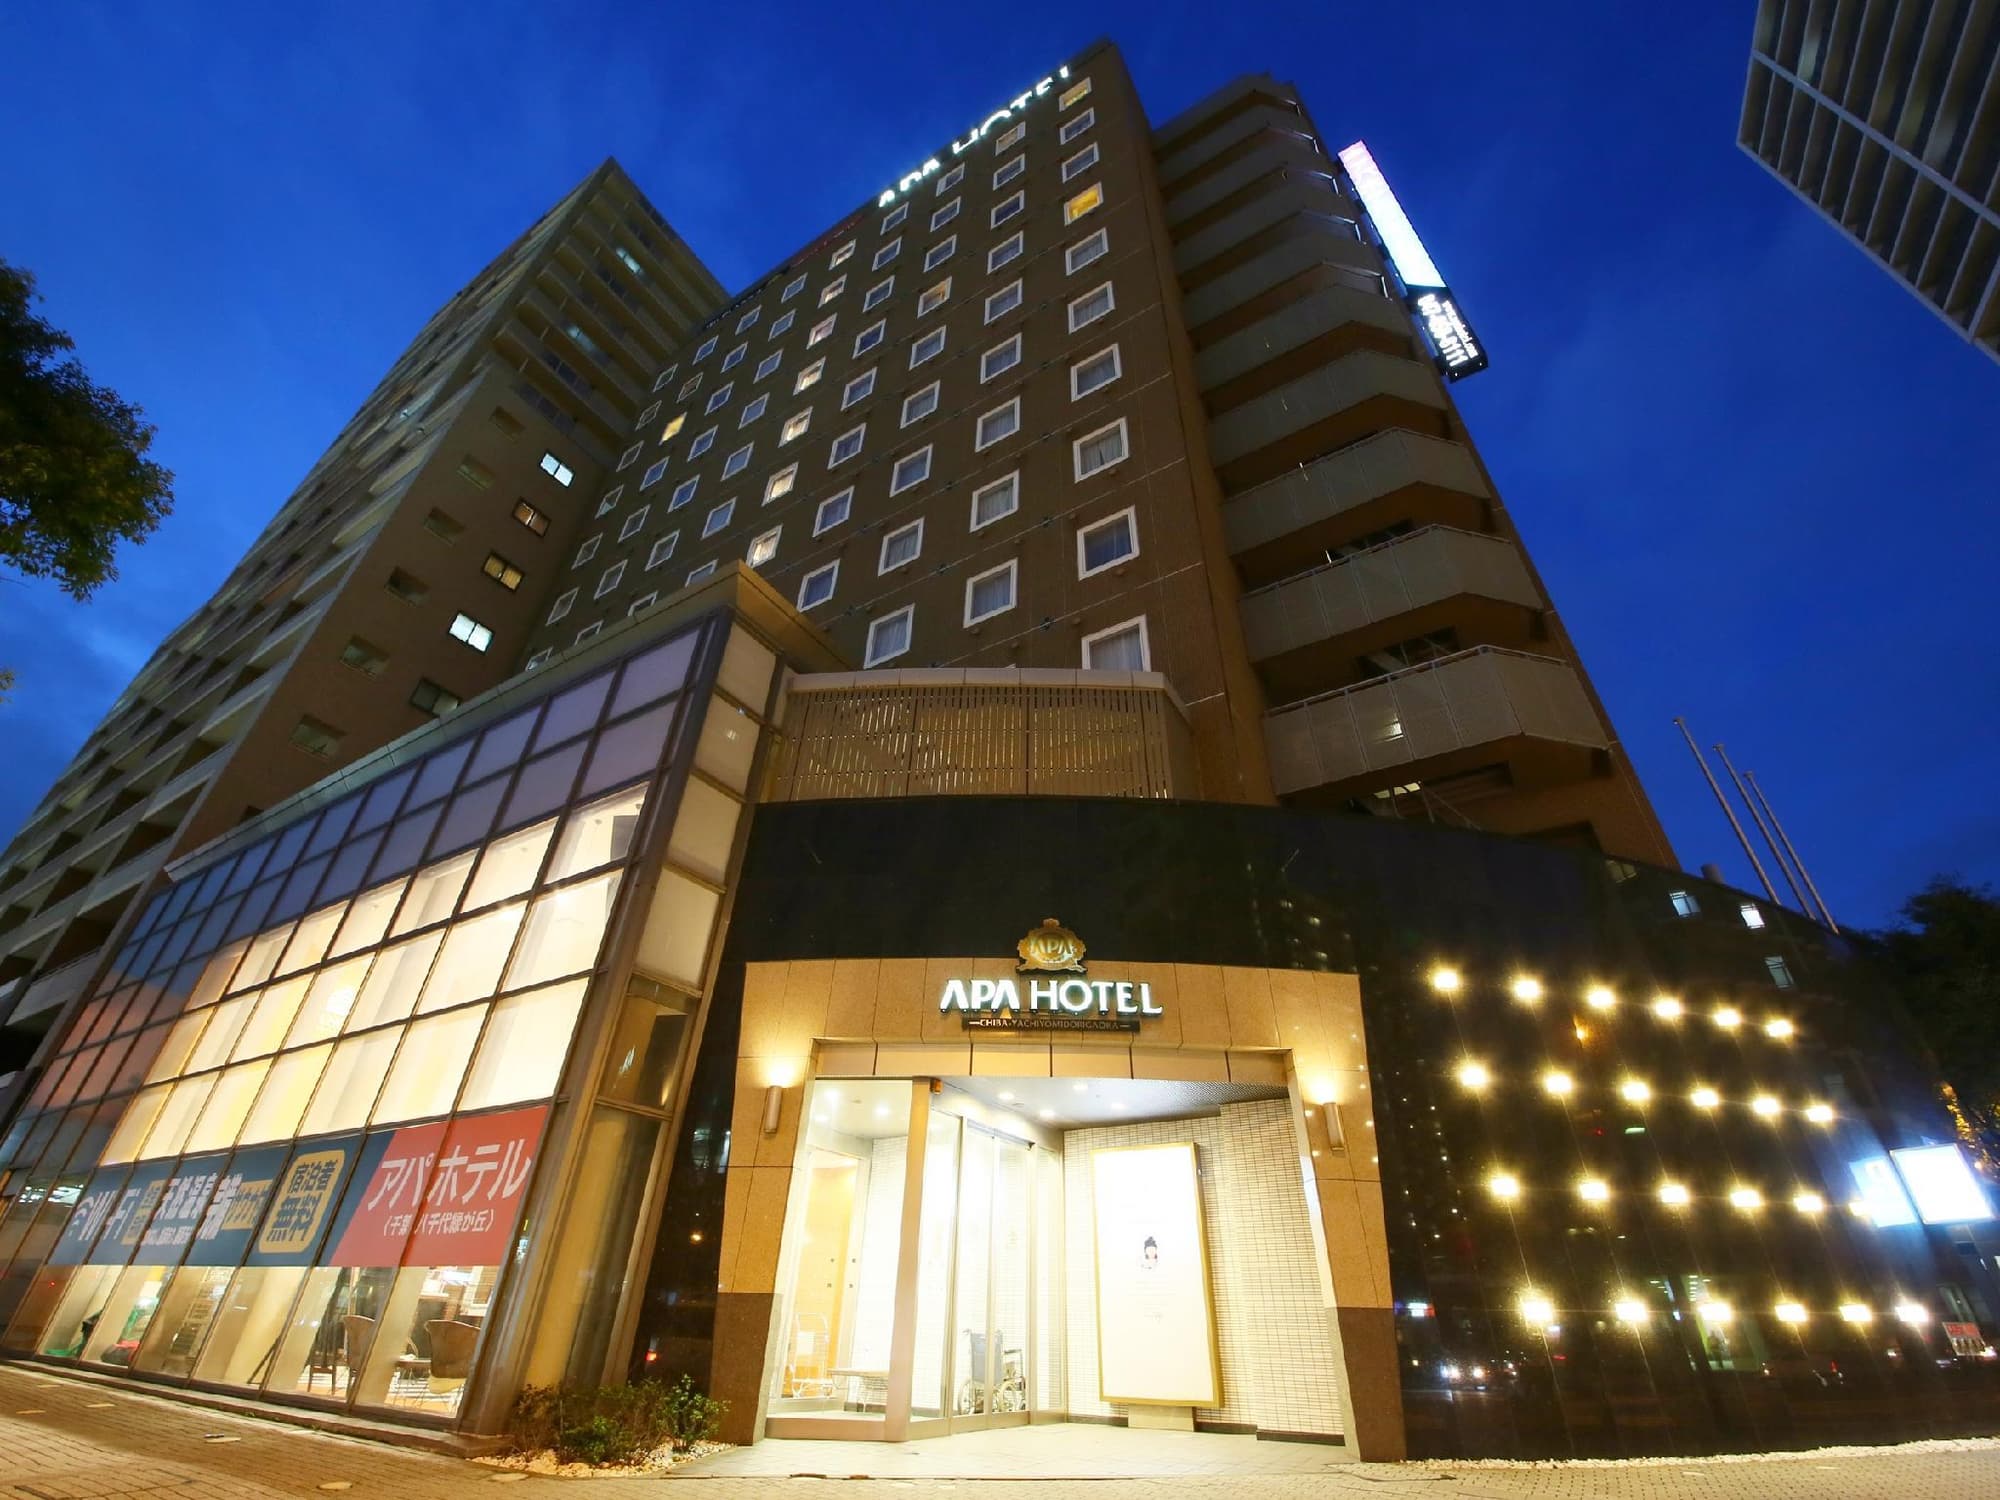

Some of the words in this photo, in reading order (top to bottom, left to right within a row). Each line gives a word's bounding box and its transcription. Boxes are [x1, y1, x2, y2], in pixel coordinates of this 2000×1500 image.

[1028, 937, 1075, 955] APA
[938, 979, 1021, 1012] APA
[1028, 978, 1164, 1016] HOTEL
[288, 1159, 339, 1194] 宿泊者
[367, 1138, 532, 1211] アパホテル
[266, 1192, 325, 1242] 無料
